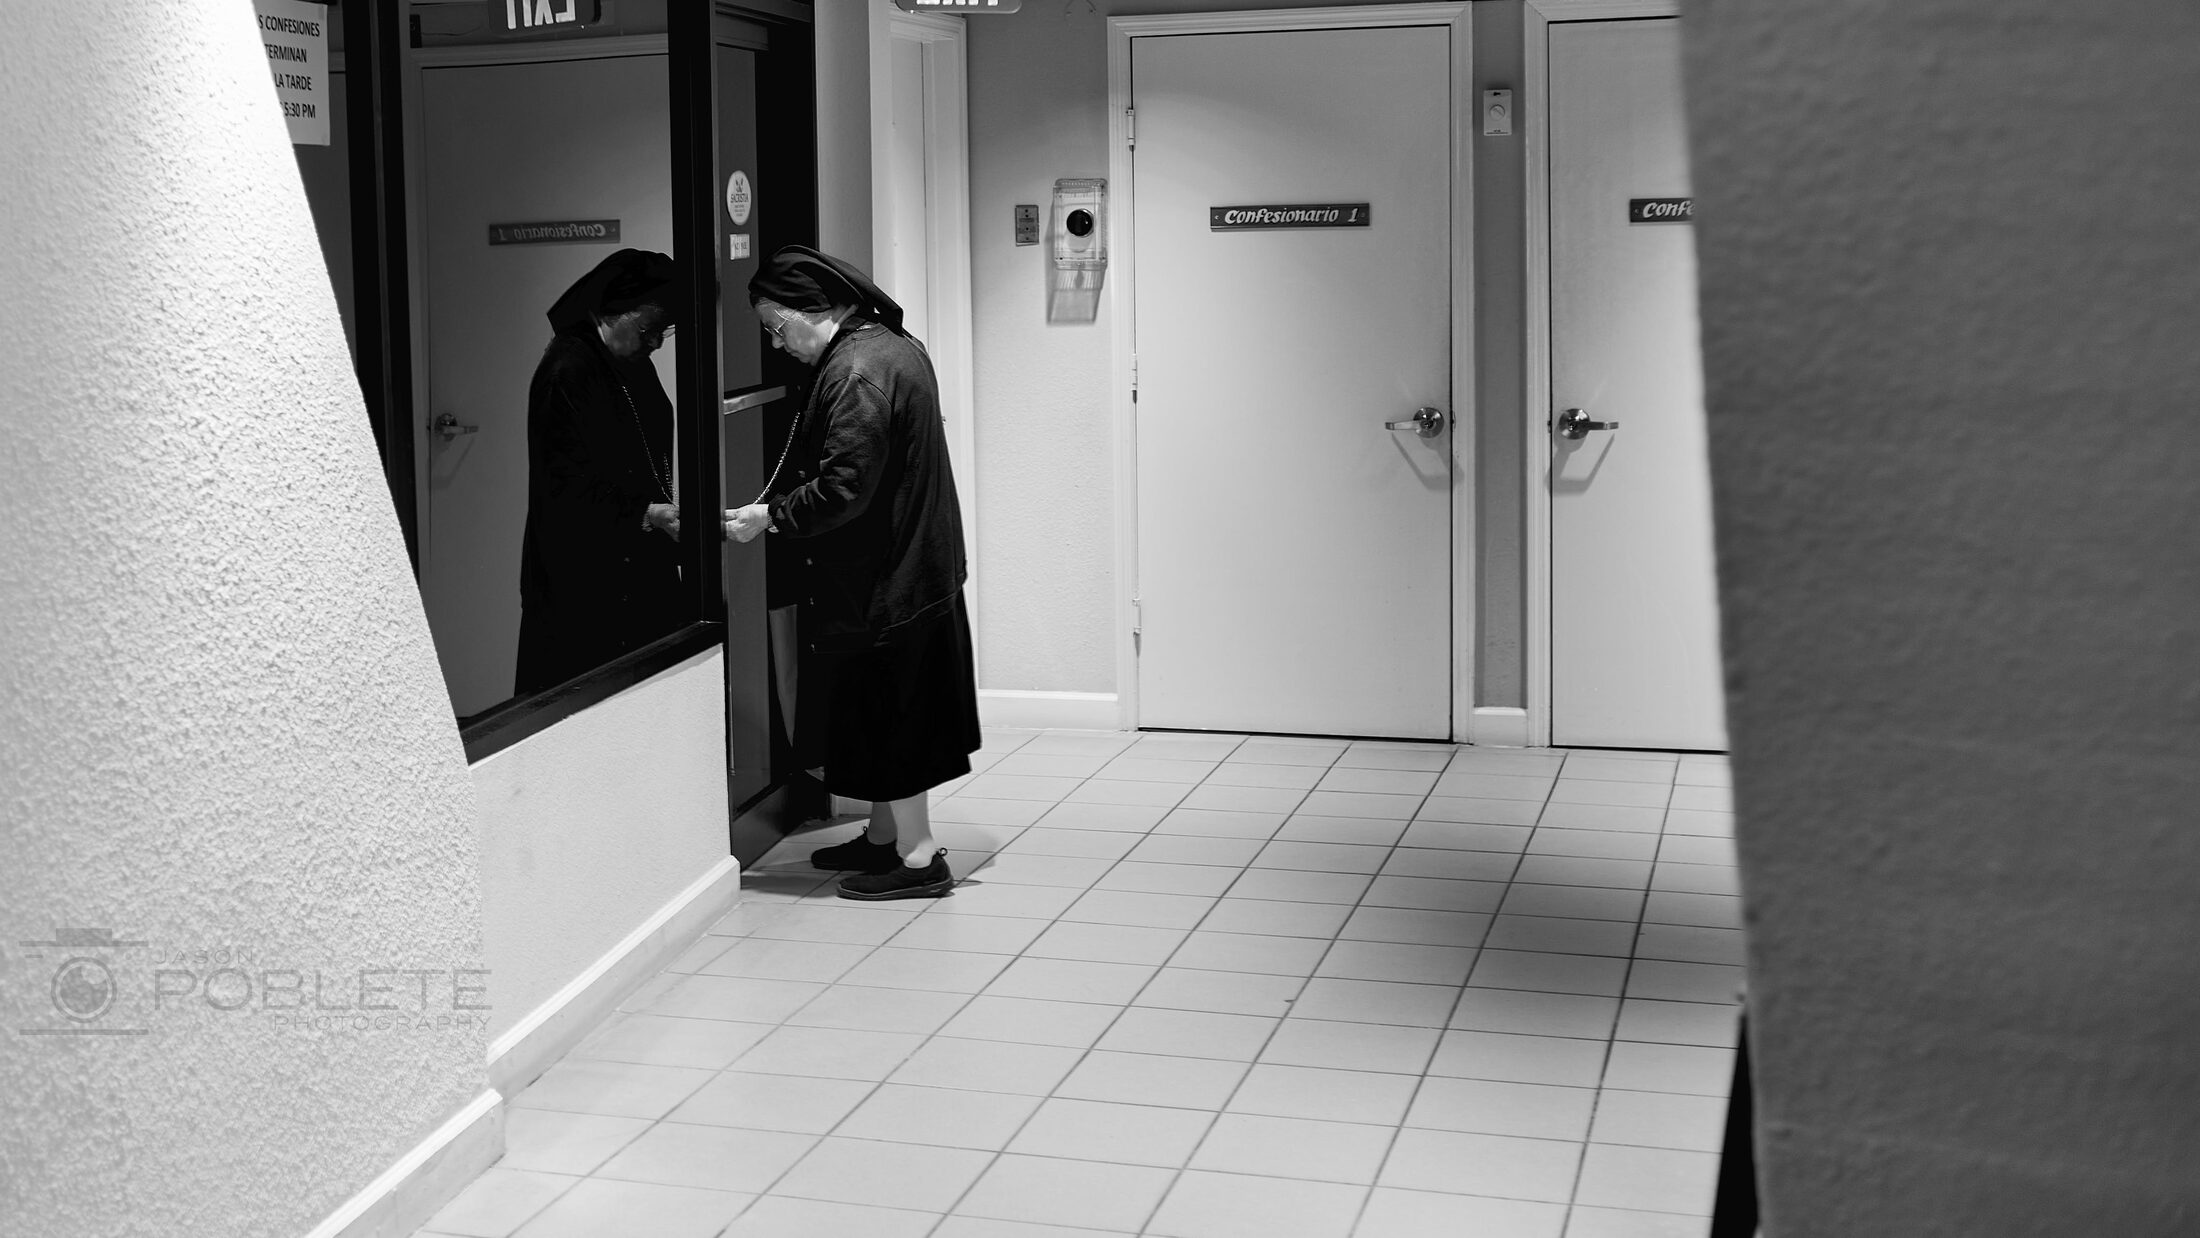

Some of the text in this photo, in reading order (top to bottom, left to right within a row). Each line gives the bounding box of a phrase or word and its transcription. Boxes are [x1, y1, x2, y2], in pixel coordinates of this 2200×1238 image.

[265, 15, 321, 37] CONFESIONES
[264, 43, 308, 63] TERMINAN
[274, 72, 312, 91] LA TARDE
[284, 101, 316, 118] 5:30 PM
[1224, 206, 1359, 224] Confesionario 1
